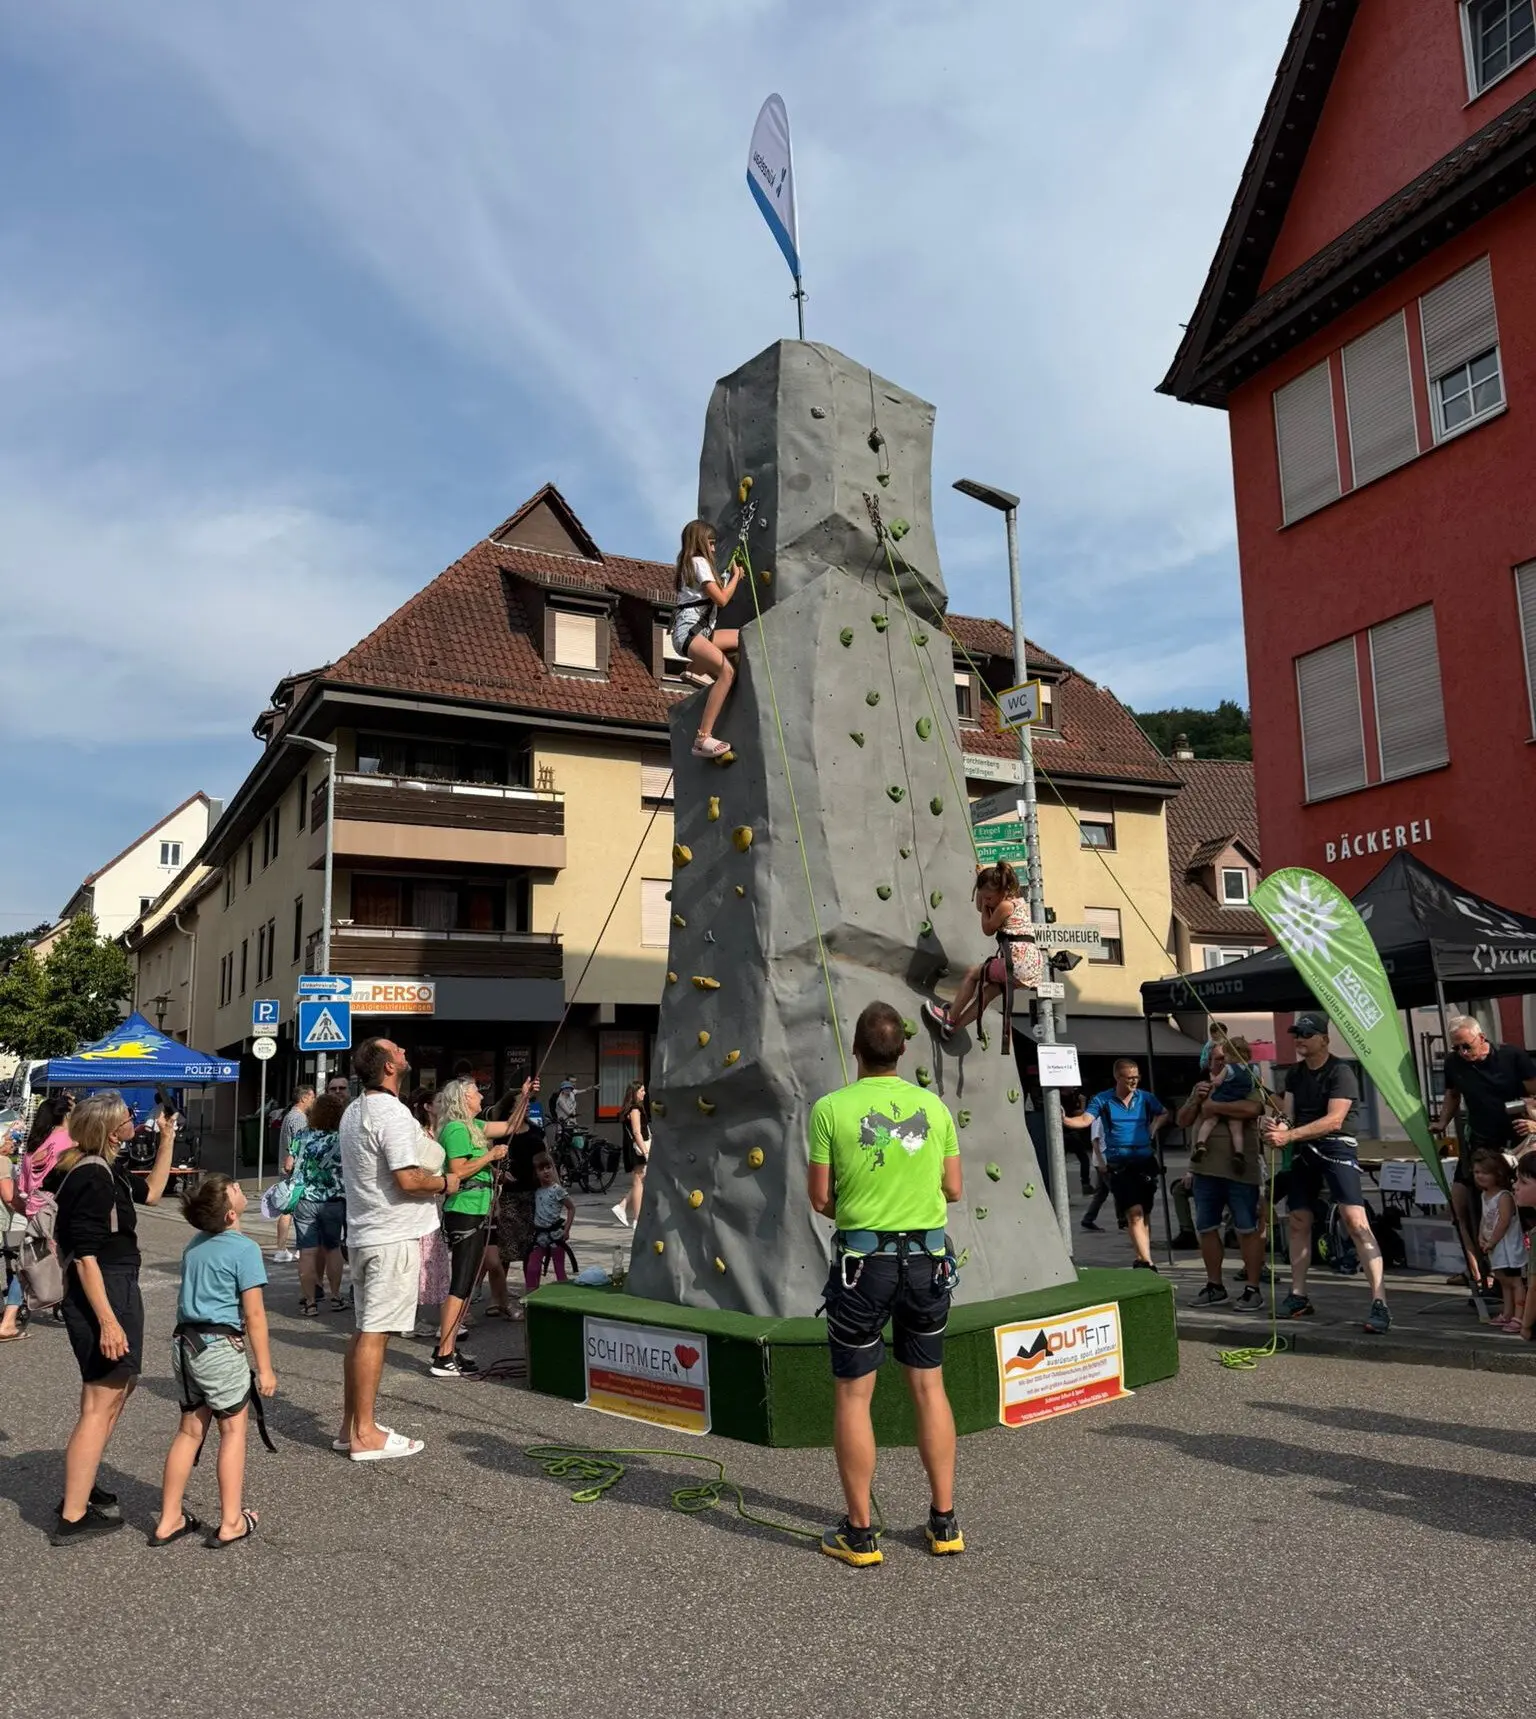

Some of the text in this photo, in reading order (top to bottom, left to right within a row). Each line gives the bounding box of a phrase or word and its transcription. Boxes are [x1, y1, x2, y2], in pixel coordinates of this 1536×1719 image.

[1007, 694, 1028, 710] WC
[1325, 819, 1432, 863] BÄCKEREI
[1034, 929, 1099, 943] WIRTSCHEUER
[184, 1066, 221, 1075] POLIZEI
[1046, 1324, 1110, 1352] OUTFIT
[587, 1337, 672, 1372] SCHIRMER
